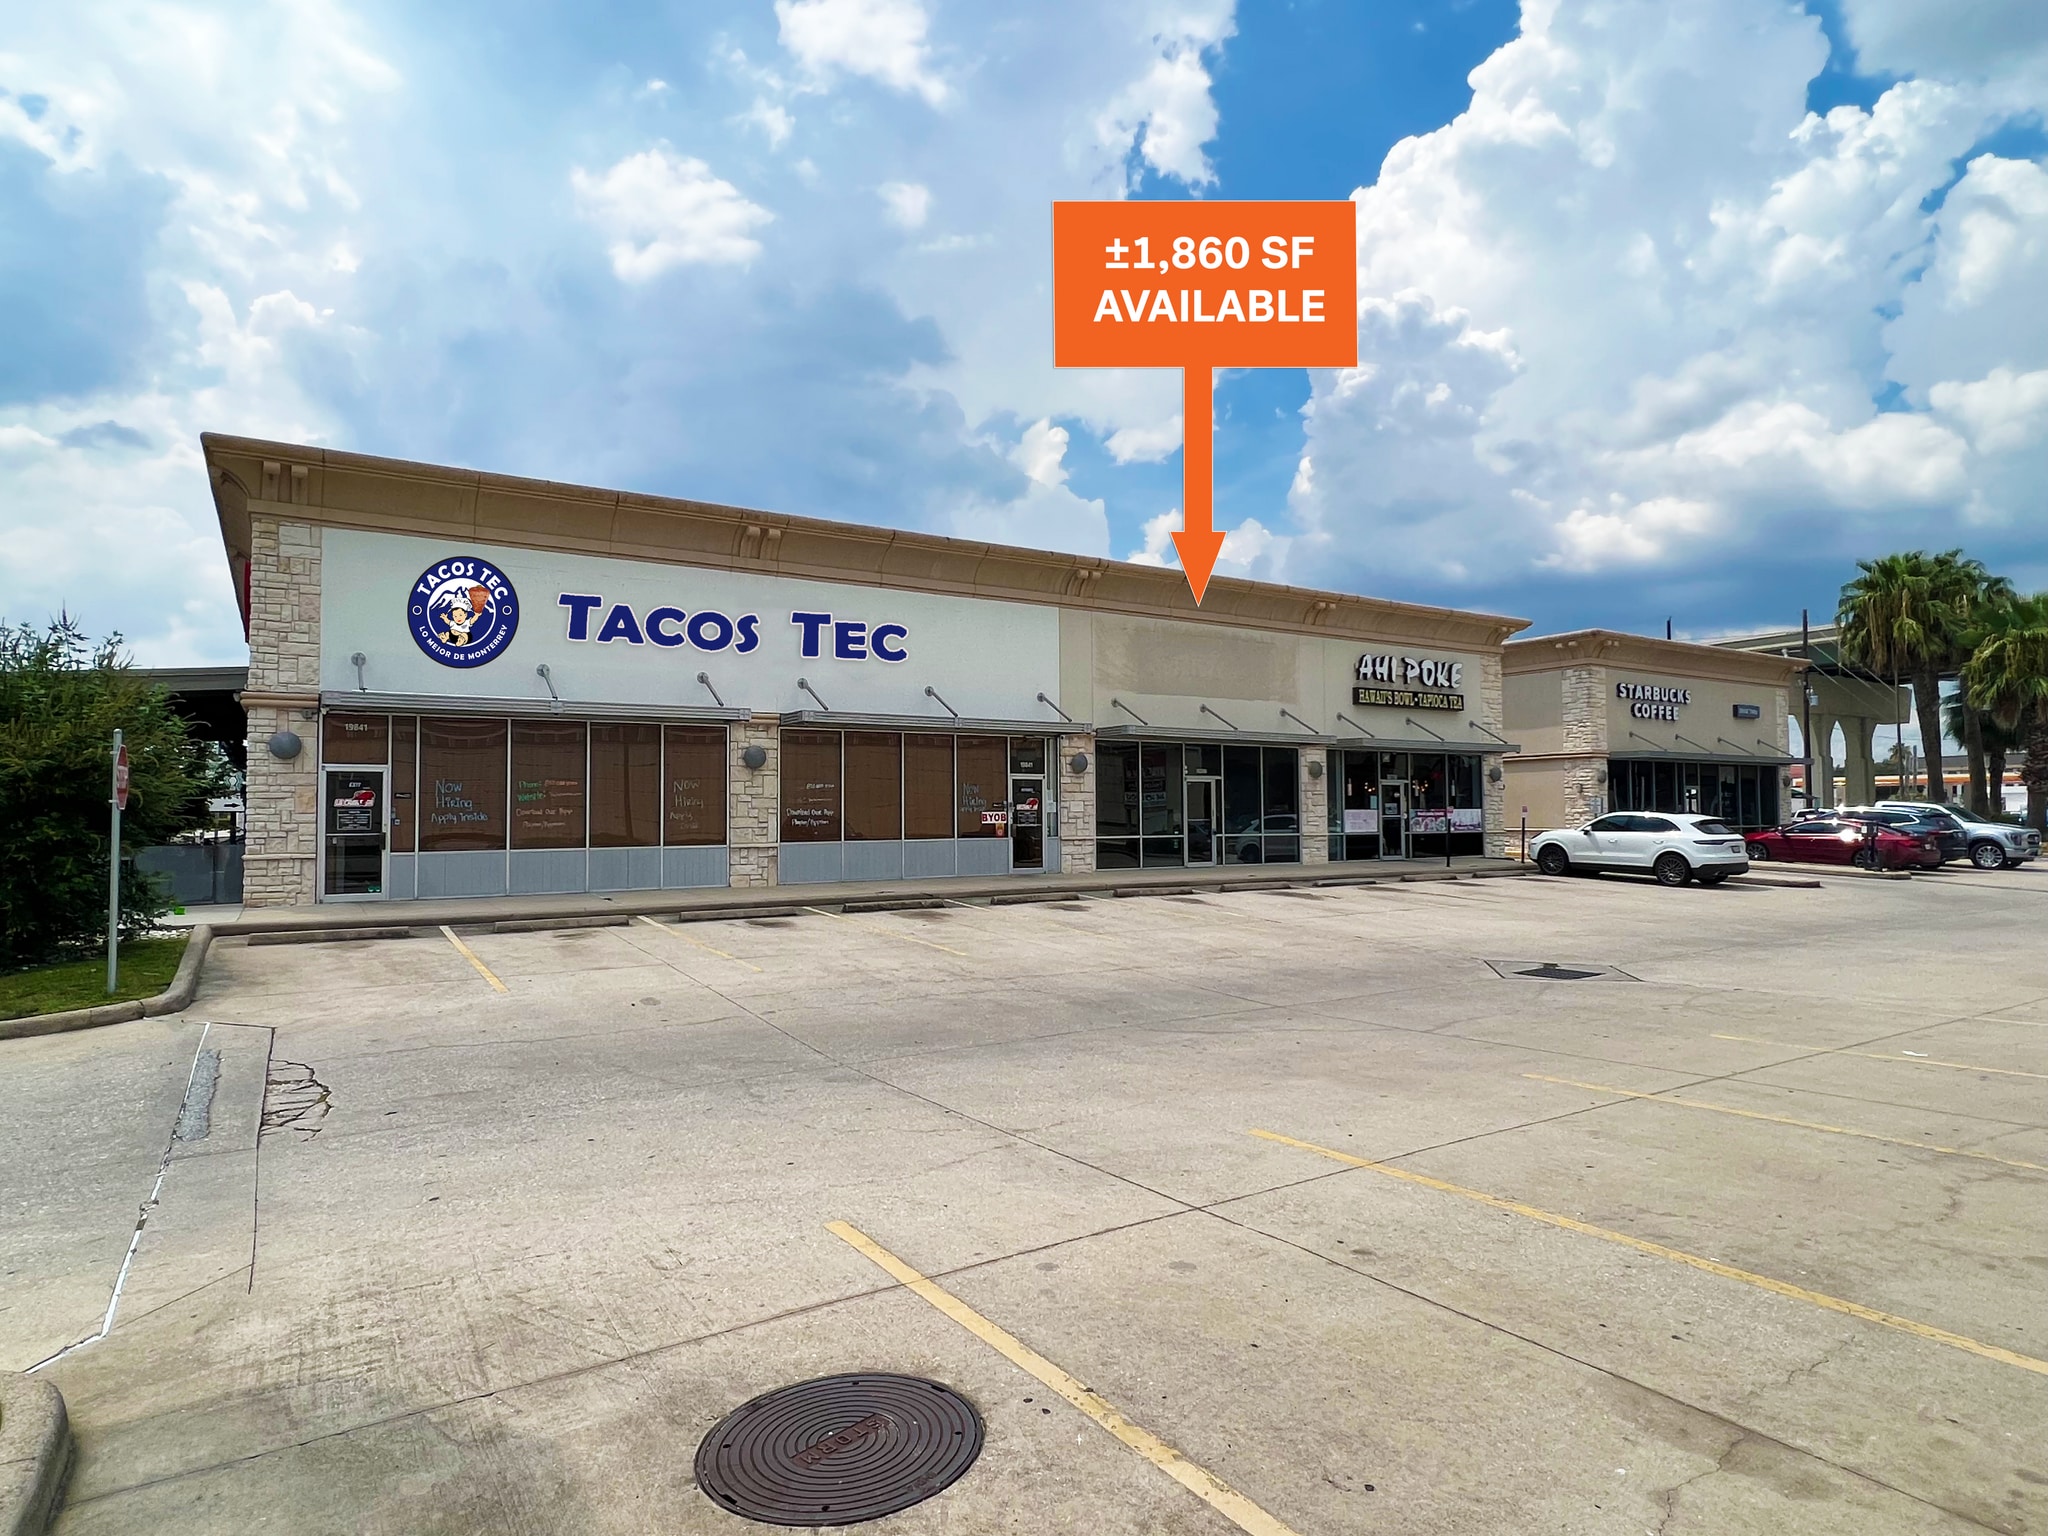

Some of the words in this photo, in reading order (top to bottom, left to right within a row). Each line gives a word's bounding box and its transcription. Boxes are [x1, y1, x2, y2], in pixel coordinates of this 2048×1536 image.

[417, 562, 474, 595] TACOS
[479, 567, 508, 600] TEC
[557, 592, 760, 655] TACOS
[790, 610, 909, 663] TEC
[419, 626, 429, 638] LO
[426, 638, 451, 658] MEJOR
[468, 624, 508, 660] MONTERREY
[1358, 654, 1397, 683] AHI
[1402, 657, 1463, 689] POKE
[1394, 691, 1415, 706] BOWL
[1418, 693, 1449, 708] TAPIOCA
[1449, 696, 1463, 709] TEA
[1617, 682, 1692, 705] STARBUCKS
[1632, 703, 1680, 721] COFFEE
[344, 723, 368, 732] 19841
[435, 795, 473, 811] Hiring
[675, 795, 704, 808] Hiring
[431, 812, 457, 824] Apply
[982, 813, 1007, 822] BYOB
[800, 1419, 882, 1464] STORM
